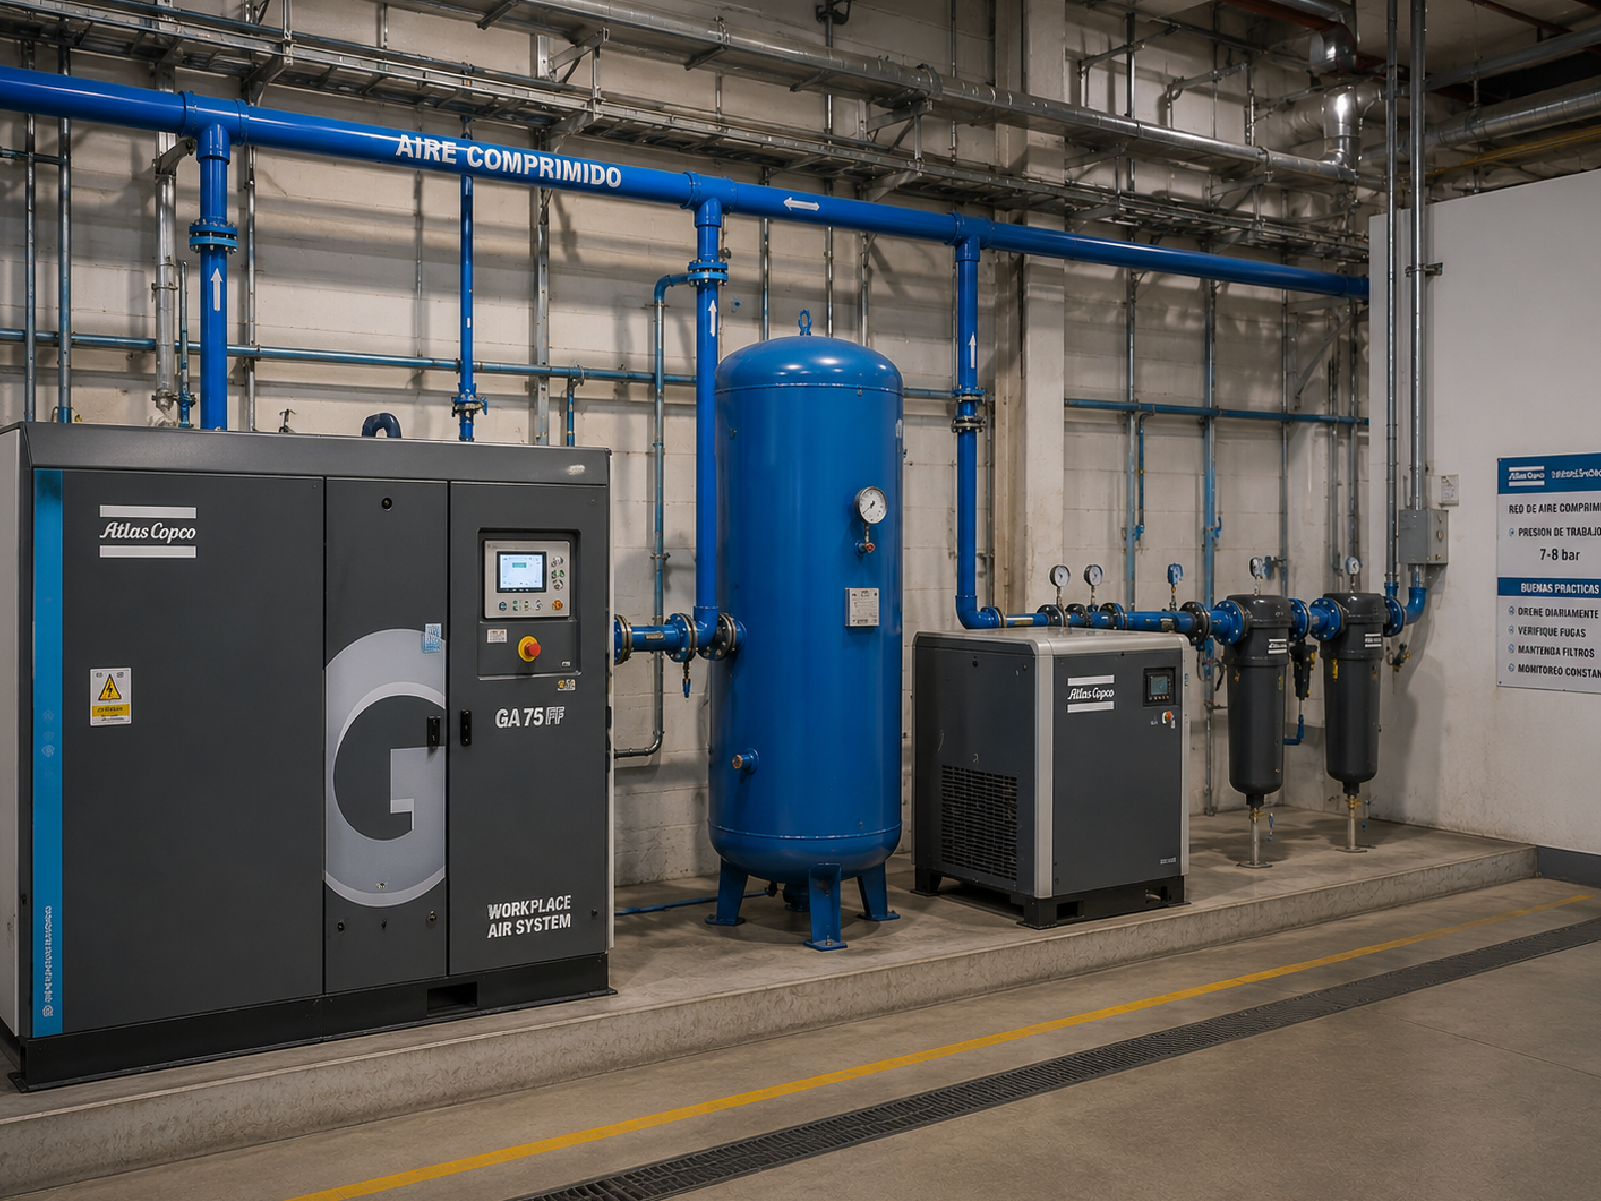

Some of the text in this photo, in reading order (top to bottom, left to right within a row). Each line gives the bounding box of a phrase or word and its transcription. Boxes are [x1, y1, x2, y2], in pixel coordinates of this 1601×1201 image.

[395, 133, 622, 188] AIRE COMPRIMIDO
[1538, 503, 1557, 513] AIRE
[99, 521, 196, 544] Atlas Copco
[1539, 548, 1580, 561] 7-8 bar
[1560, 628, 1587, 638] FUGAS
[1562, 647, 1595, 658] FILTROS
[1067, 688, 1092, 700] Atlas
[495, 708, 521, 729] GA
[487, 894, 572, 920] WORKPLACE
[486, 913, 571, 938] AIR SYSTEM
